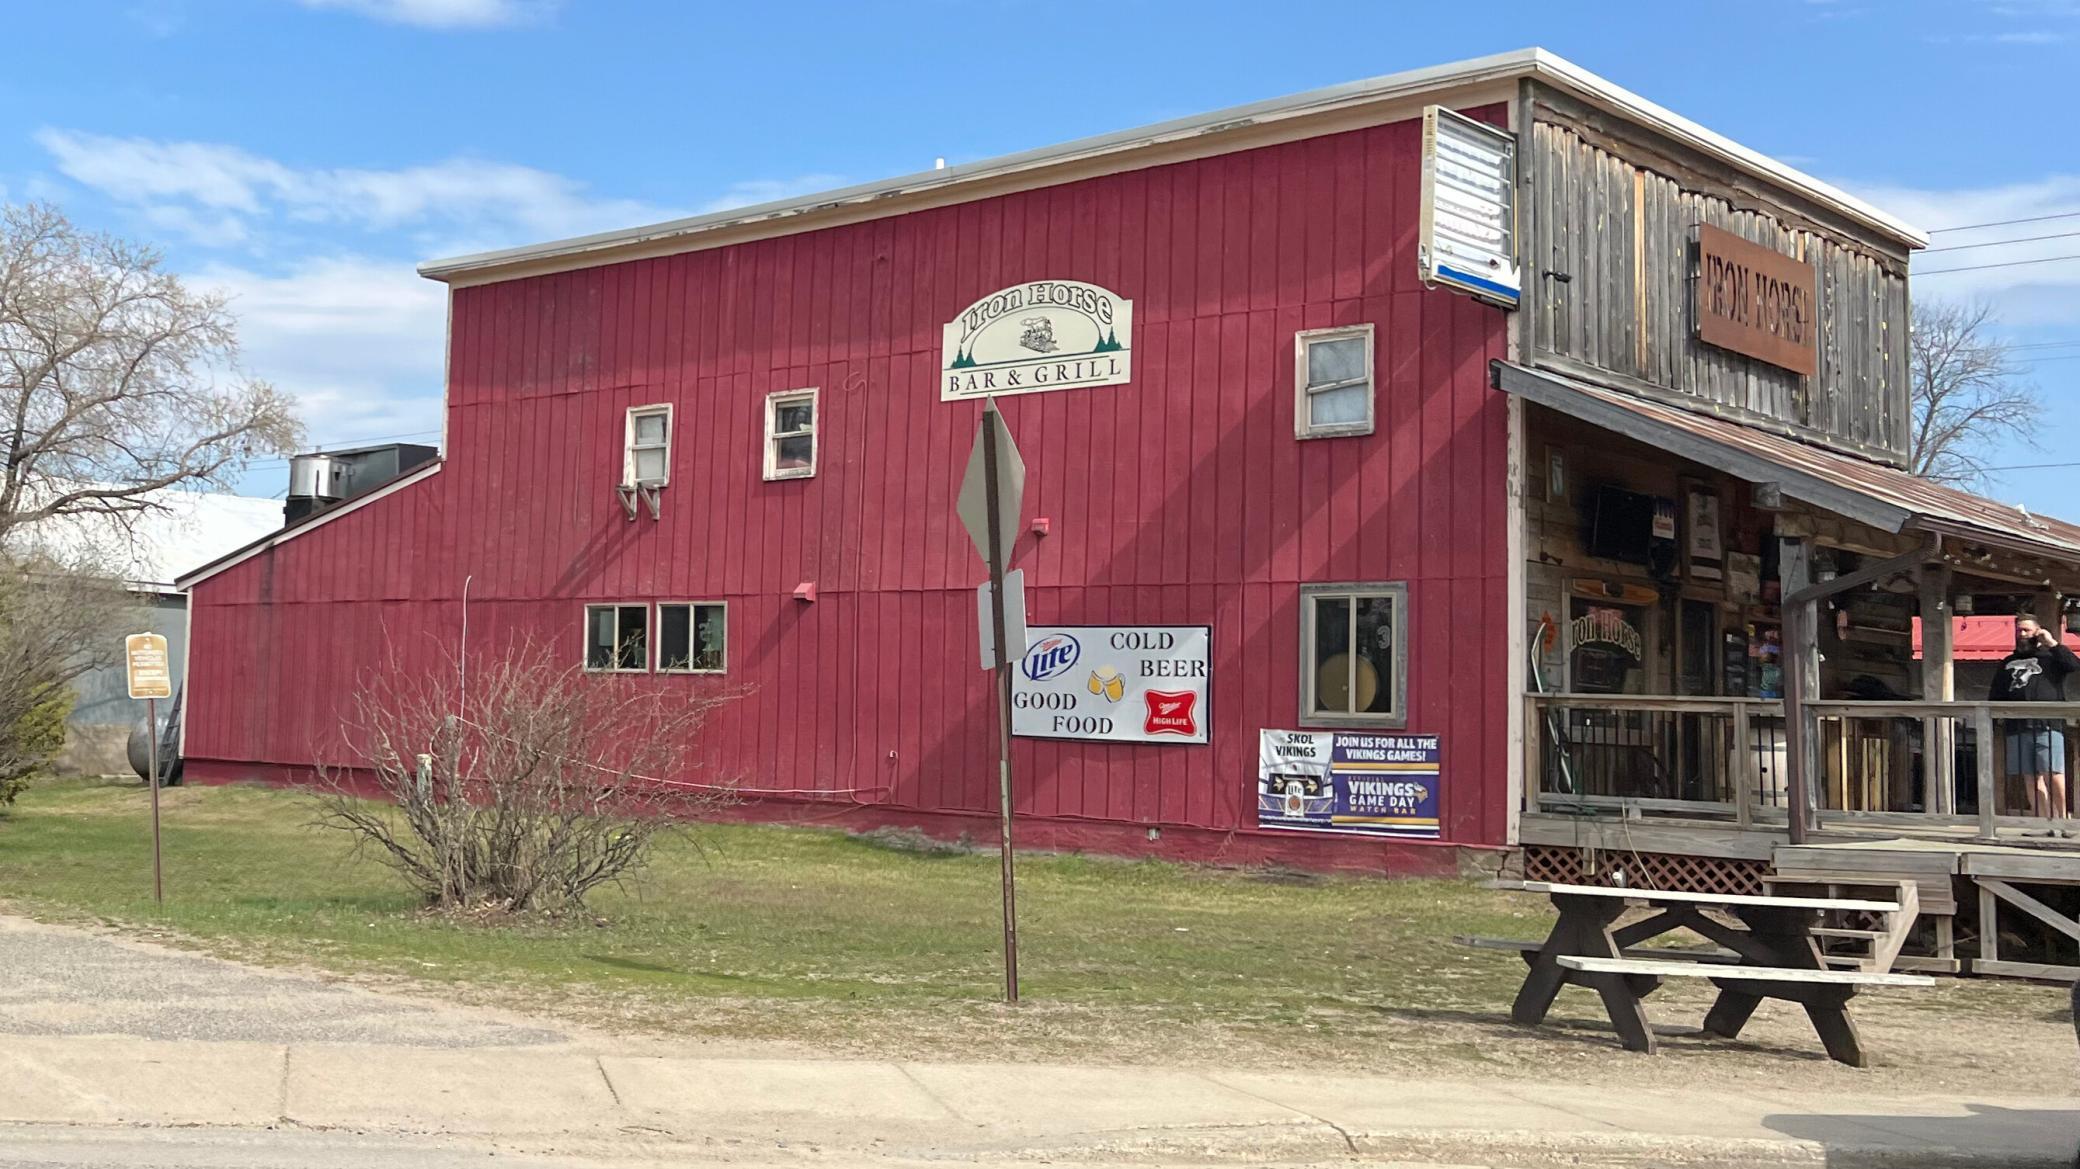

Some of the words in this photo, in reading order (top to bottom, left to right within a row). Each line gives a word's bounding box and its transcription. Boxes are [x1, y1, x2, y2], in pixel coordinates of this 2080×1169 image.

[1706, 252, 1749, 327] IRON
[1028, 283, 1113, 325] Horse
[949, 372, 996, 392] BAR
[1008, 369, 1022, 386] &
[1034, 359, 1121, 384] GRILL
[1110, 632, 1174, 650] COLD
[1031, 644, 1073, 681] Lite
[1140, 659, 1206, 678] BEER
[1014, 691, 1077, 710] GOOD
[1052, 715, 1114, 735] FOOD
[1287, 733, 1315, 744] SKOL
[1335, 736, 1359, 747] JOIN
[1360, 737, 1373, 748] US
[1375, 737, 1395, 748] FOR
[1396, 738, 1415, 749] ALL
[1416, 738, 1437, 750] THE
[1275, 745, 1317, 758] VIKINGS
[1345, 748, 1386, 761] VIKINGS
[1386, 750, 1426, 762] GAMES!
[1348, 781, 1415, 797] VIKINGS
[1349, 794, 1385, 807] GAME
[1389, 796, 1415, 808] DAY
[1349, 805, 1387, 814] WATCH
